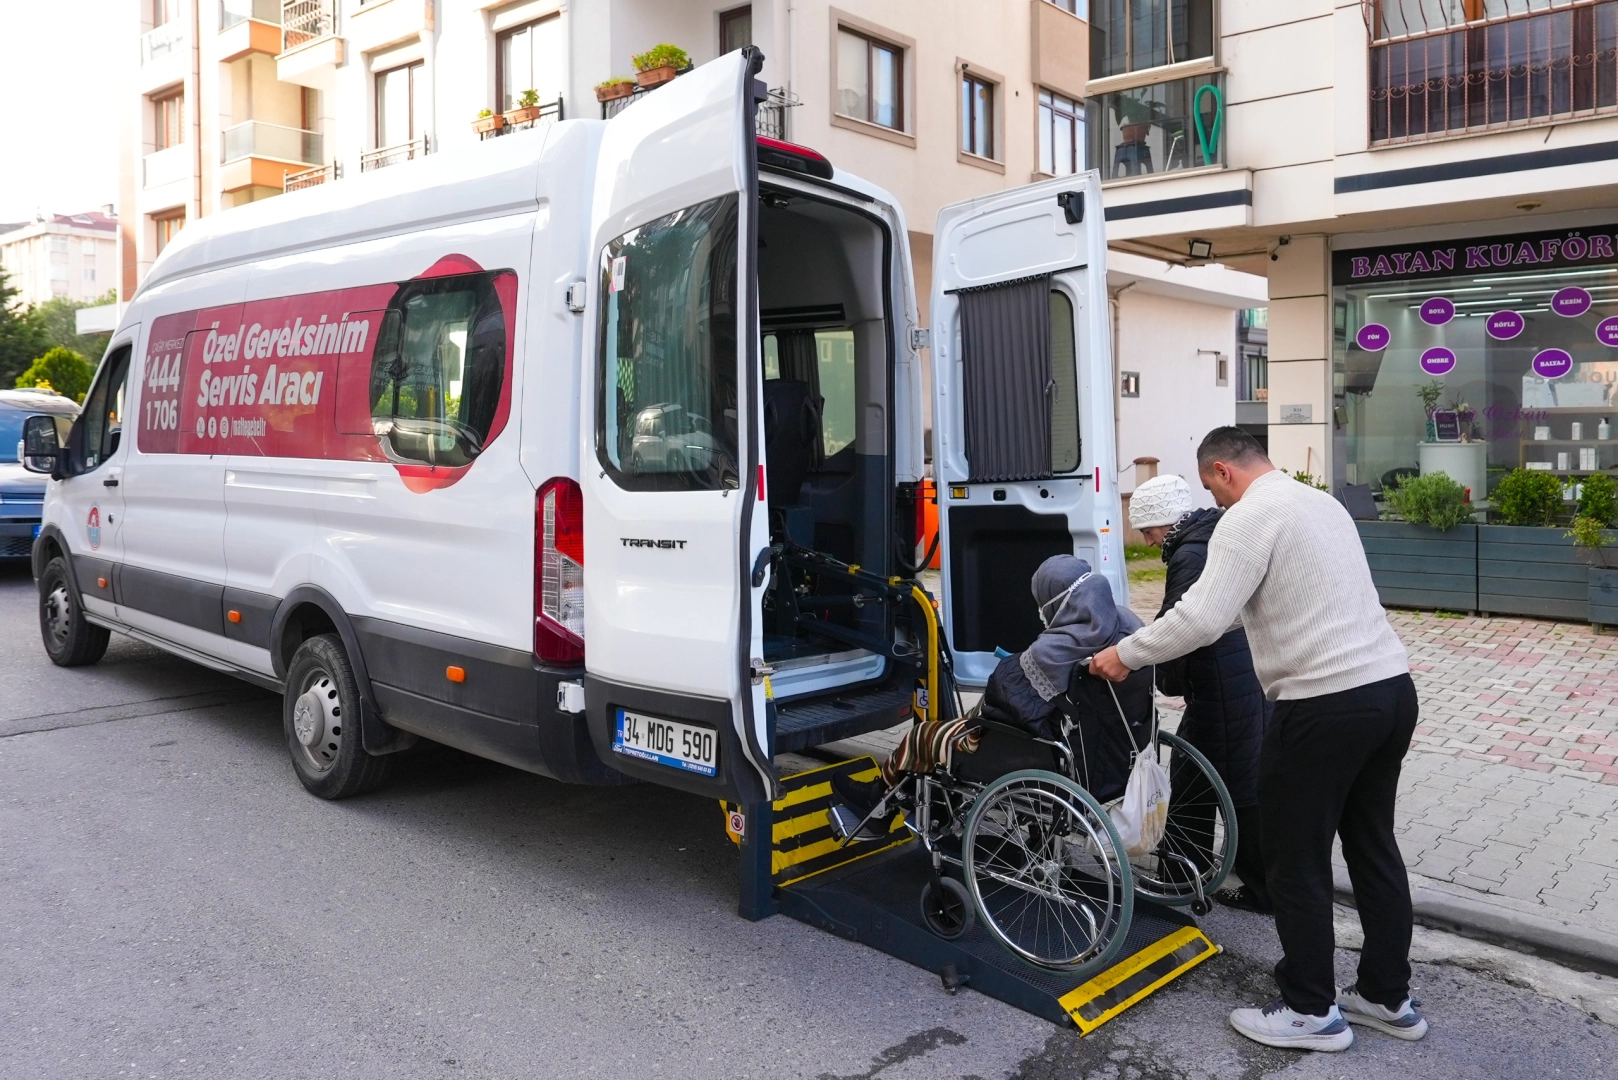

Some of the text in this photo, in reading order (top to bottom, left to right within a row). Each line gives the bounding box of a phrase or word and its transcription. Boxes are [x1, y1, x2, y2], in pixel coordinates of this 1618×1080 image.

[1351, 231, 1618, 278] BAYAN KUAFÖR
[203, 312, 370, 364] Özel Gereksinim
[148, 353, 182, 394] 444
[198, 363, 259, 408] Servis
[258, 364, 324, 407] Aracı
[146, 399, 178, 431] 1706
[619, 537, 688, 549] TRANSIT
[617, 729, 623, 737] TR
[624, 716, 712, 763] 34 MDG 590
